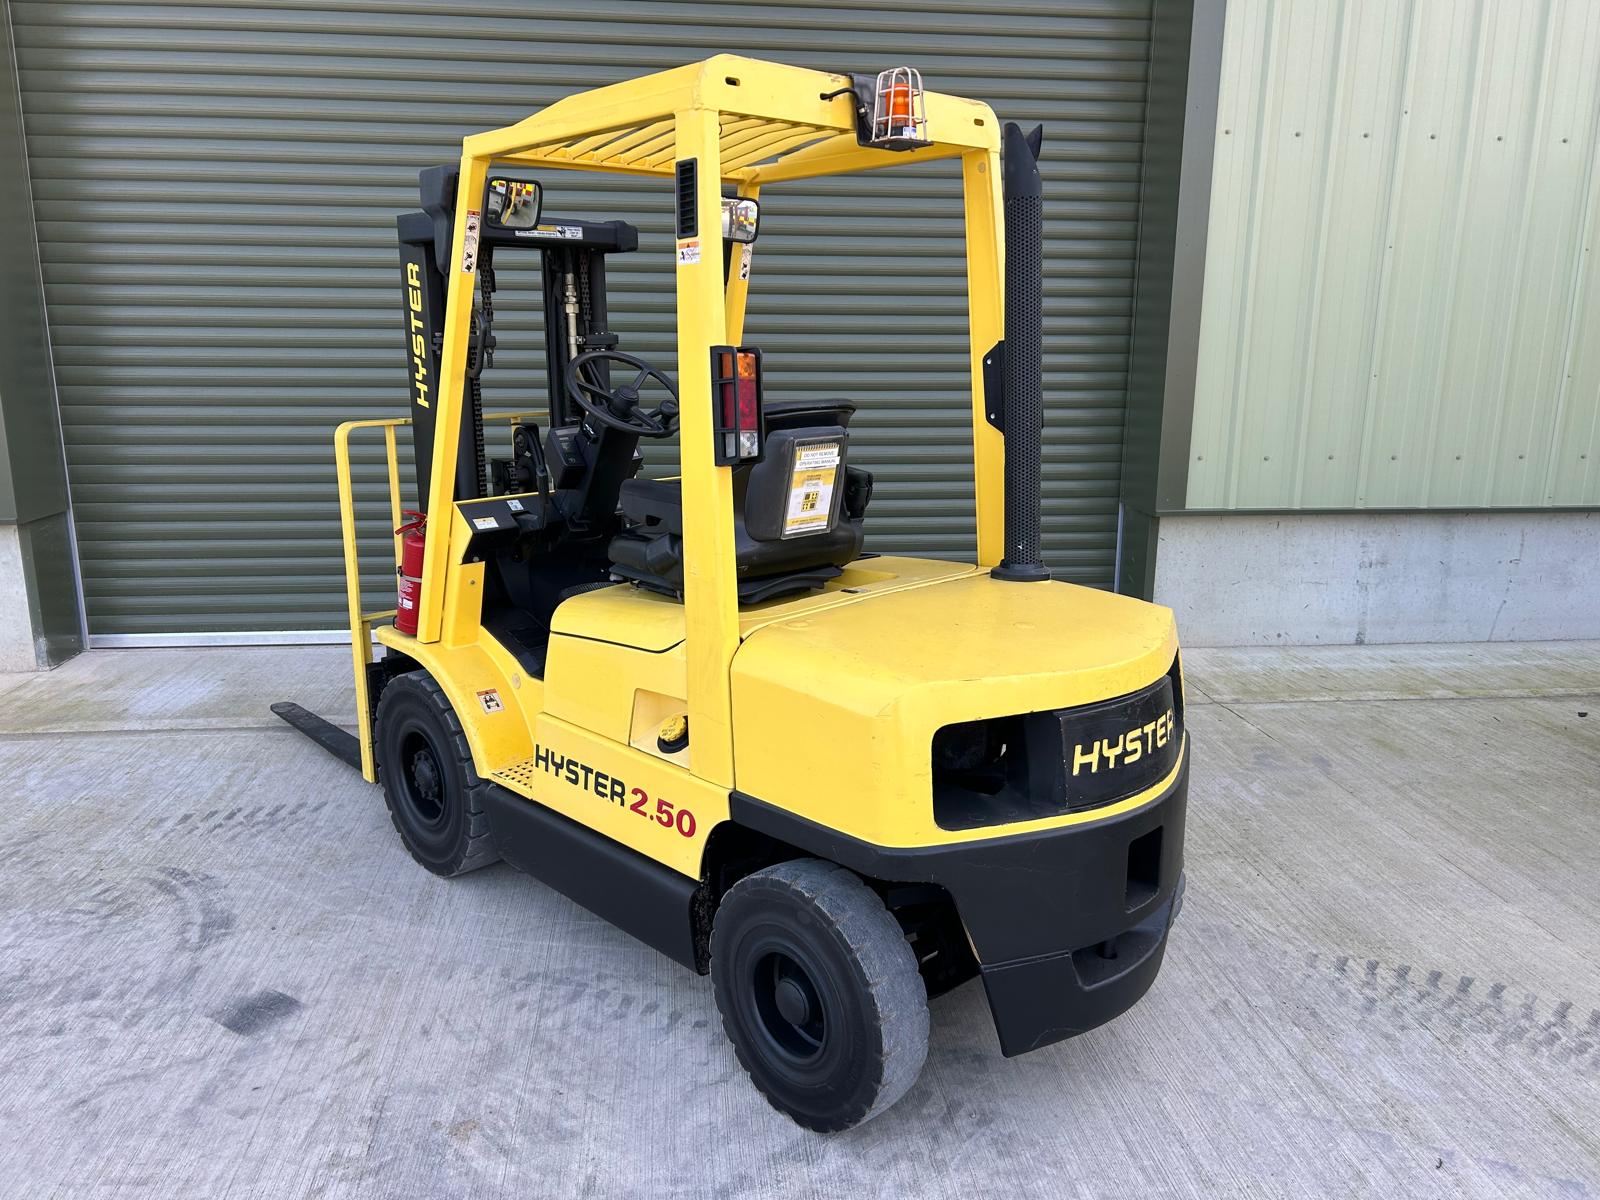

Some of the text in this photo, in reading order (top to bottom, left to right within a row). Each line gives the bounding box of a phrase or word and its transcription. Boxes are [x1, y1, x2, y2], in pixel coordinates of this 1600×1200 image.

[406, 262, 430, 409] HYSTER
[1072, 708, 1174, 776] HYSTER
[534, 743, 697, 838] HYSTER 2.50
